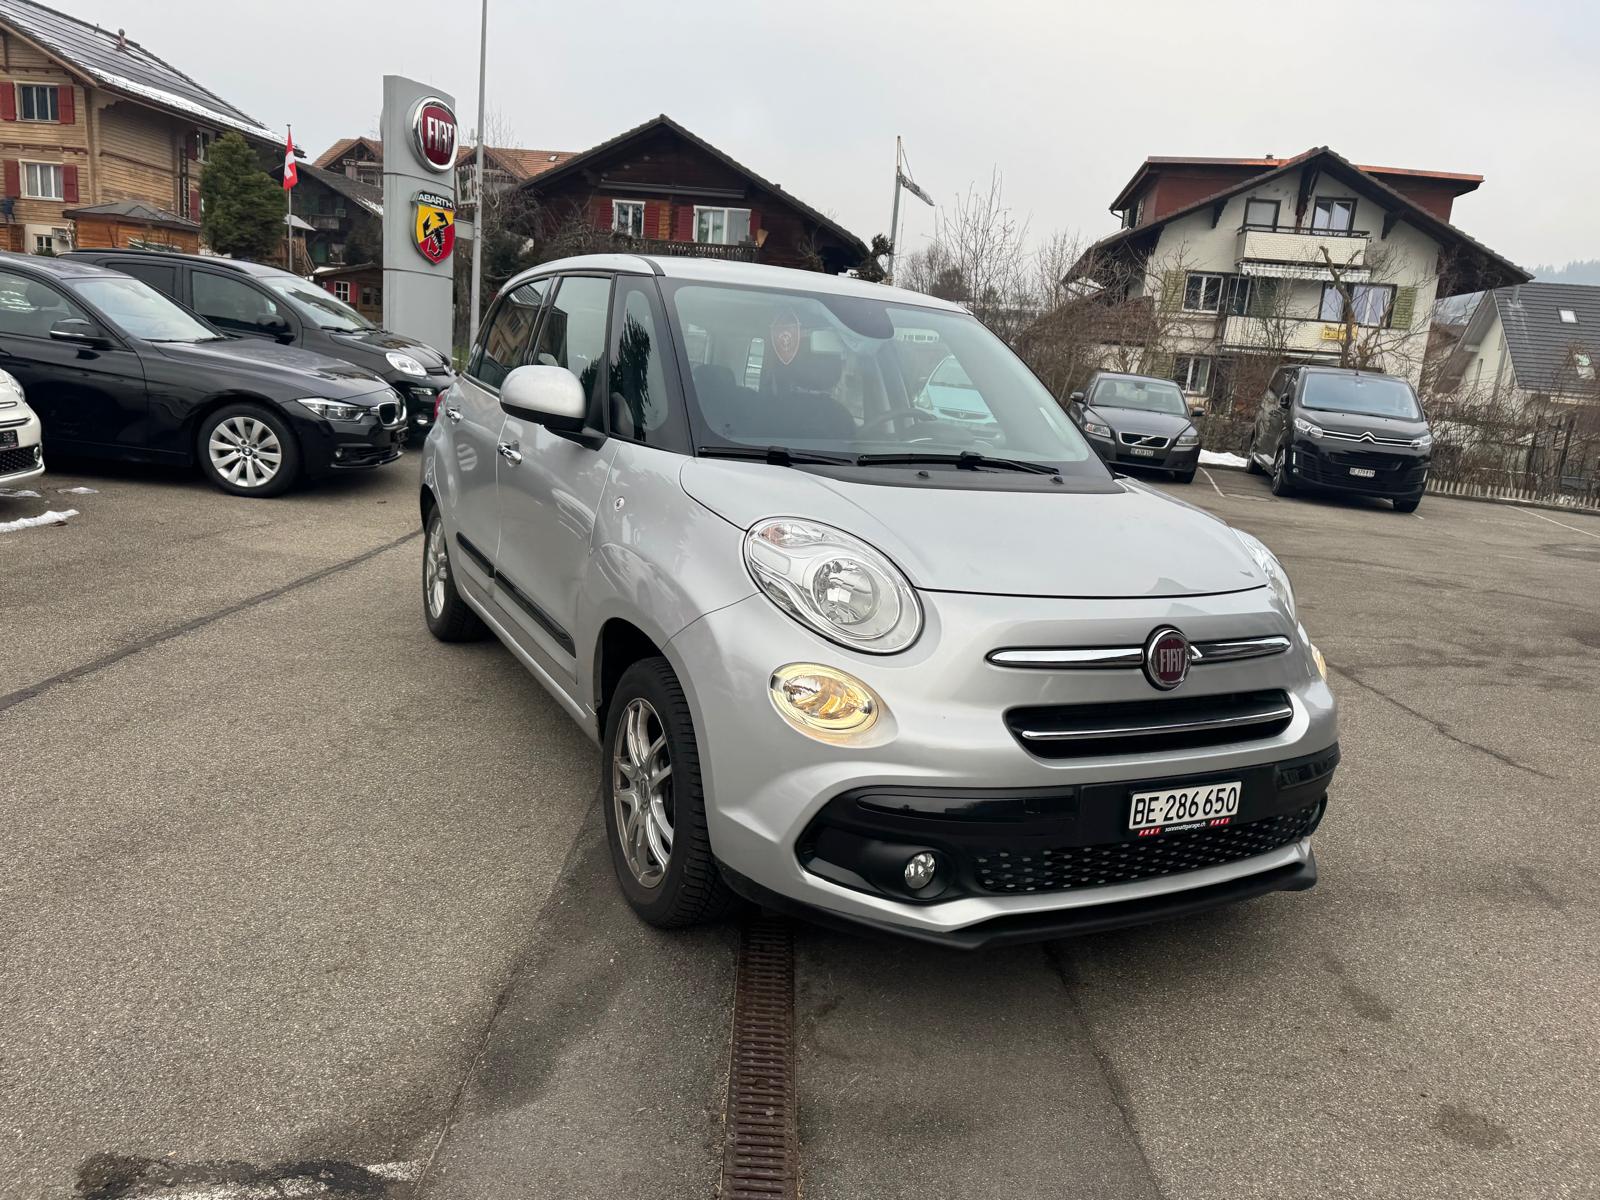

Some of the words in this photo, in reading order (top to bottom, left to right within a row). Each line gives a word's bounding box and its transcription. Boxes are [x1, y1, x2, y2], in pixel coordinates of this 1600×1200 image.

[427, 116, 453, 154] FIAT
[418, 194, 452, 208] ABARTH
[1160, 648, 1183, 673] FIAT
